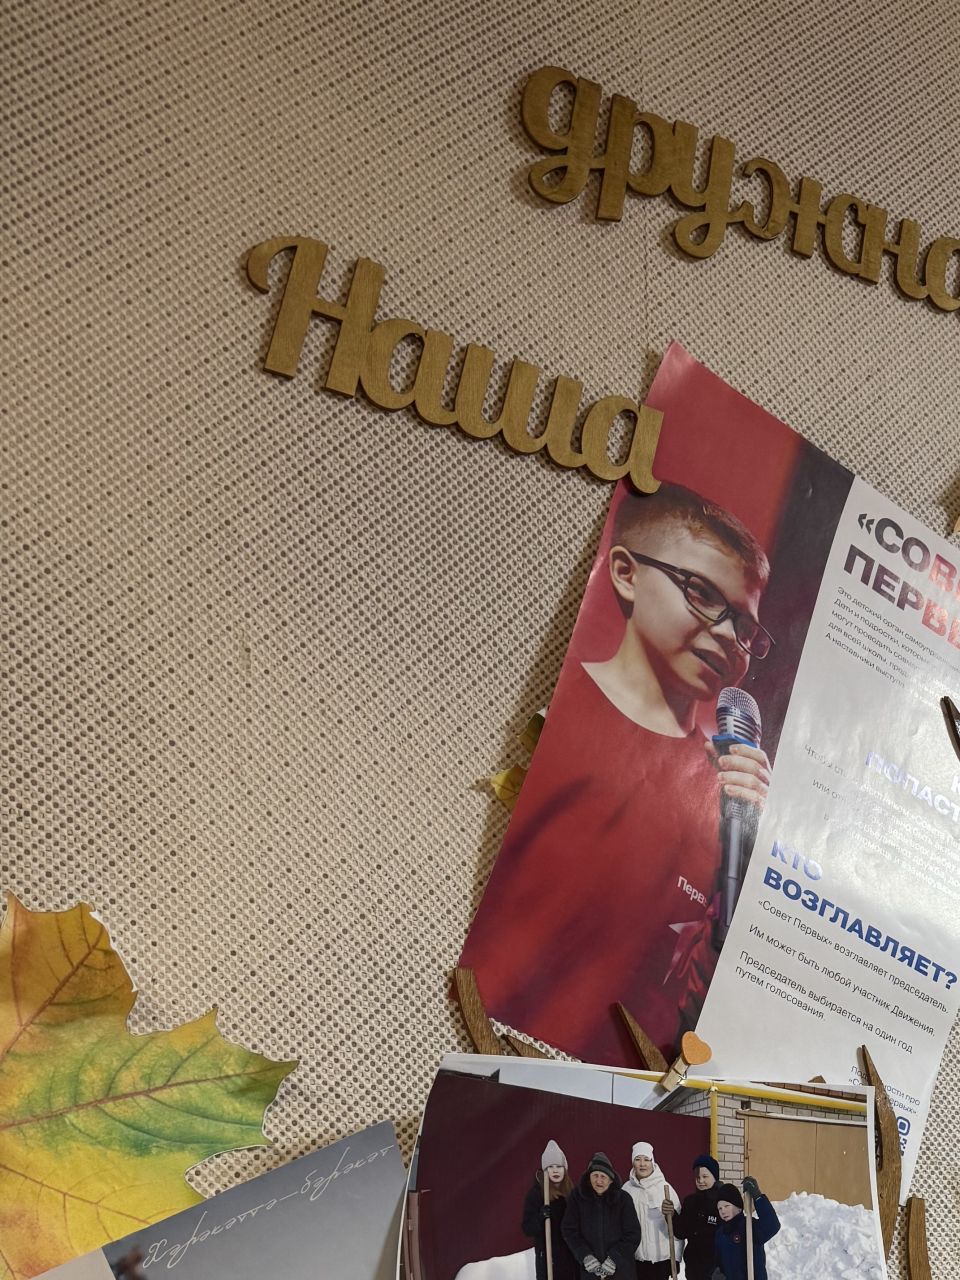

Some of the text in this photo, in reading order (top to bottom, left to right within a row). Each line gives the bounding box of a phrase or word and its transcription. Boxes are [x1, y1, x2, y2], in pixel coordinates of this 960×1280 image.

[246, 235, 664, 494] Наша
[832, 610, 853, 627] могут
[834, 598, 853, 614] Дети
[838, 586, 852, 600] Это
[852, 598, 881, 619] детский
[770, 839, 823, 881] КТО
[758, 900, 792, 924] «Совет
[793, 917, 832, 946] Первых»
[834, 942, 888, 978] возглавляет
[763, 867, 958, 989] ВОЗГЛАВЛЯЕТ?
[735, 965, 826, 1022] путем голосования.
[749, 924, 764, 939] Им
[766, 932, 797, 957] может
[797, 952, 820, 971] быть
[821, 964, 852, 988] любой
[852, 981, 890, 1011] участник
[739, 950, 913, 1054] Председатель выбирается на один год
